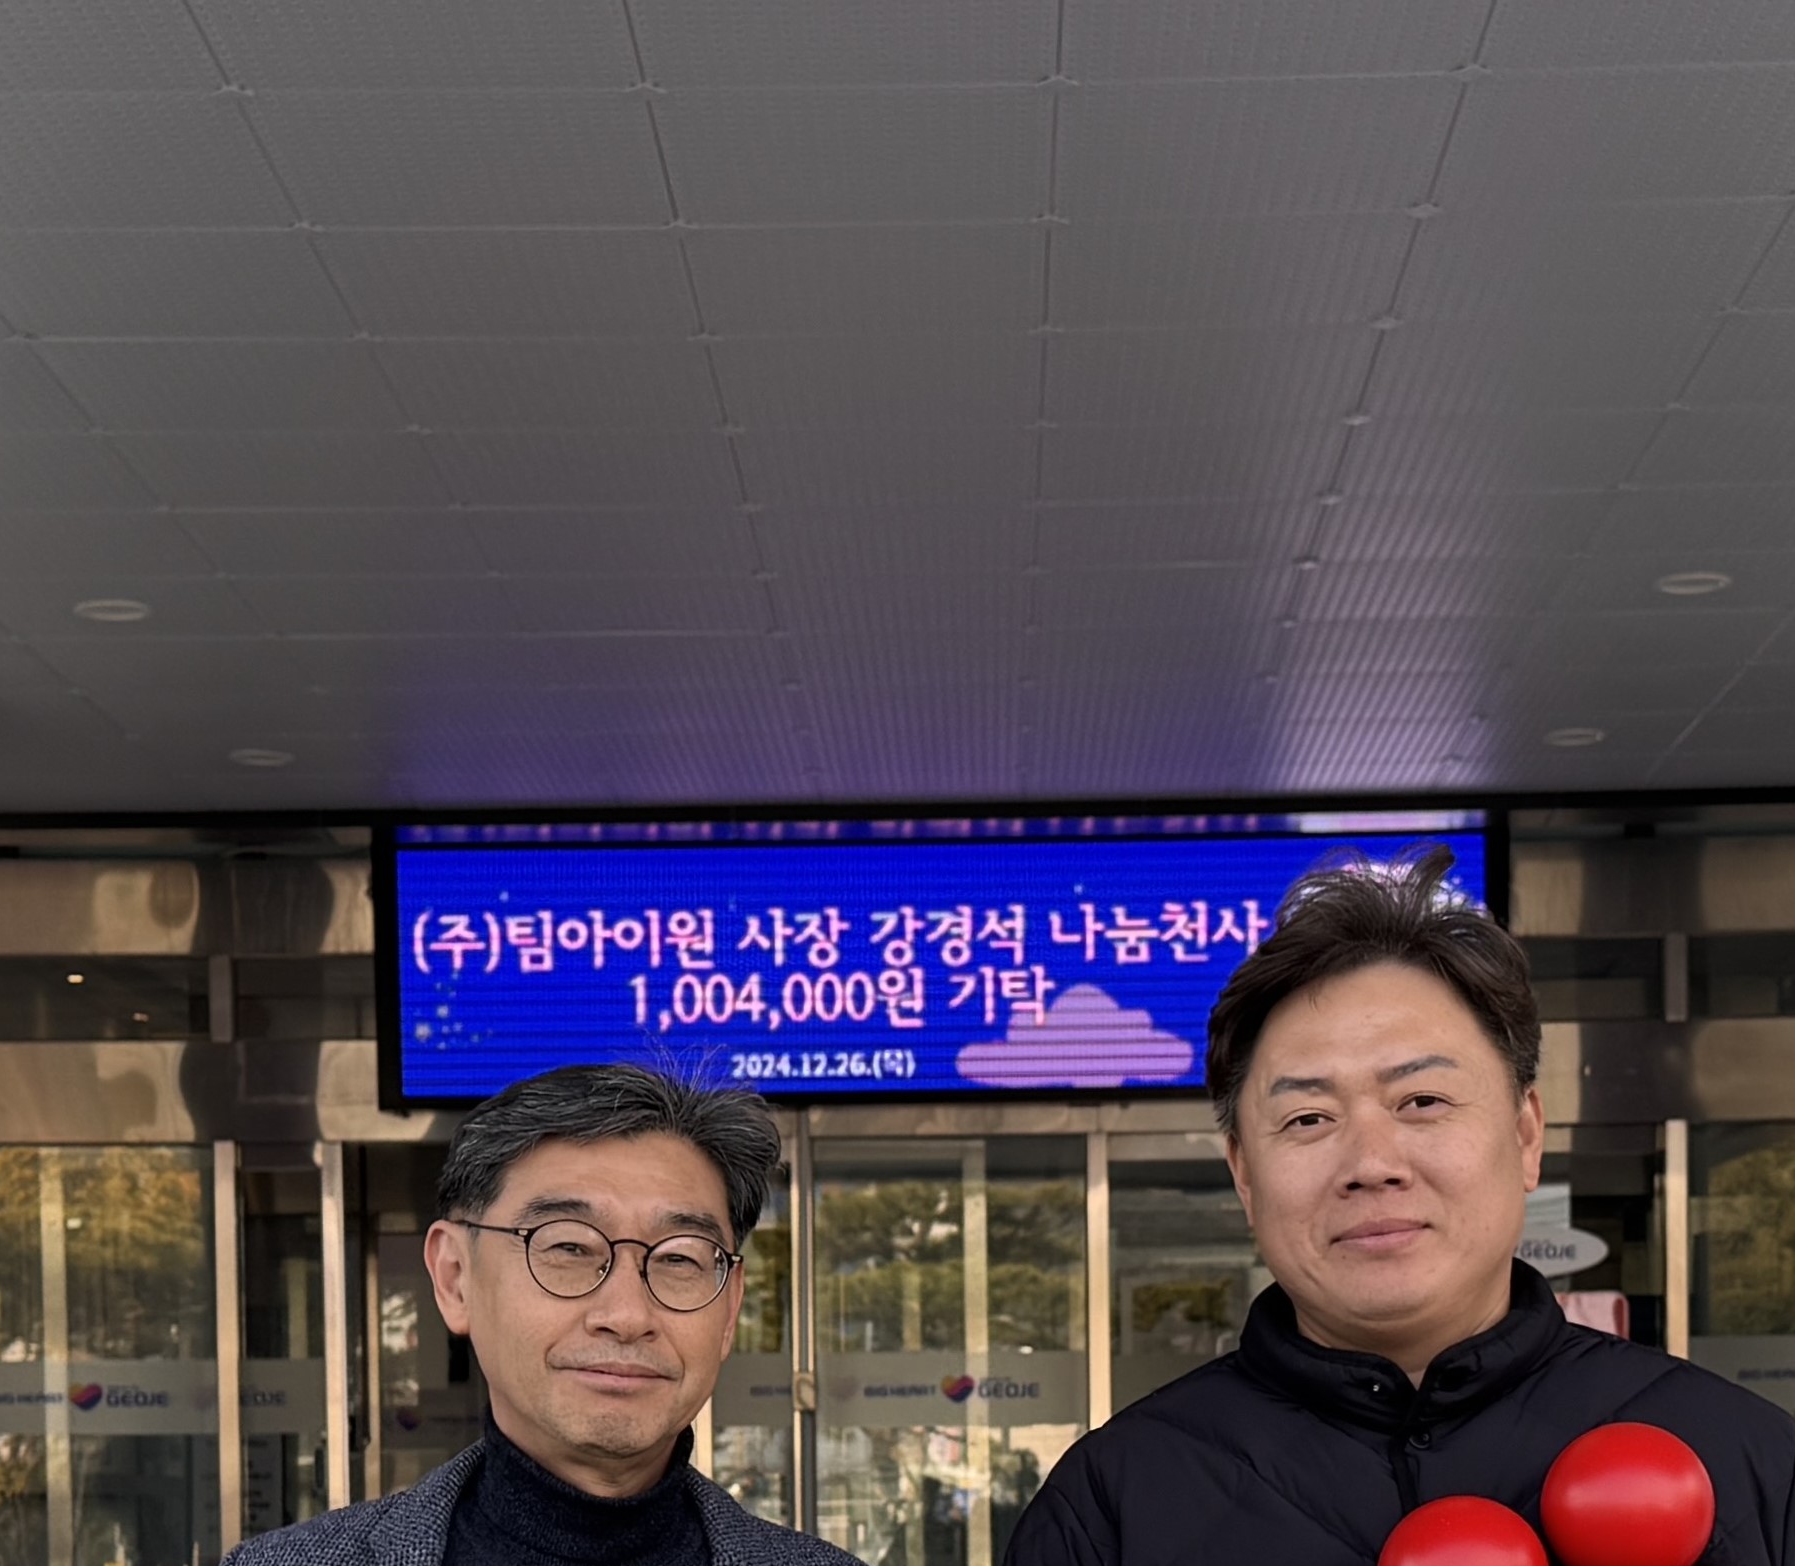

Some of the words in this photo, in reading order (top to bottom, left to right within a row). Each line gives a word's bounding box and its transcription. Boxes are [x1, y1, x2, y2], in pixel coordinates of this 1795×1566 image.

[412, 908, 715, 974] (주)팀아이원
[738, 906, 851, 969] 사장
[870, 904, 1026, 968] 강경석
[1049, 899, 1268, 964] 나눔천사
[628, 967, 925, 1031] 1,004,000원
[948, 965, 1055, 1027] 기탁
[731, 1048, 916, 1080] 2024.12.26.(목)
